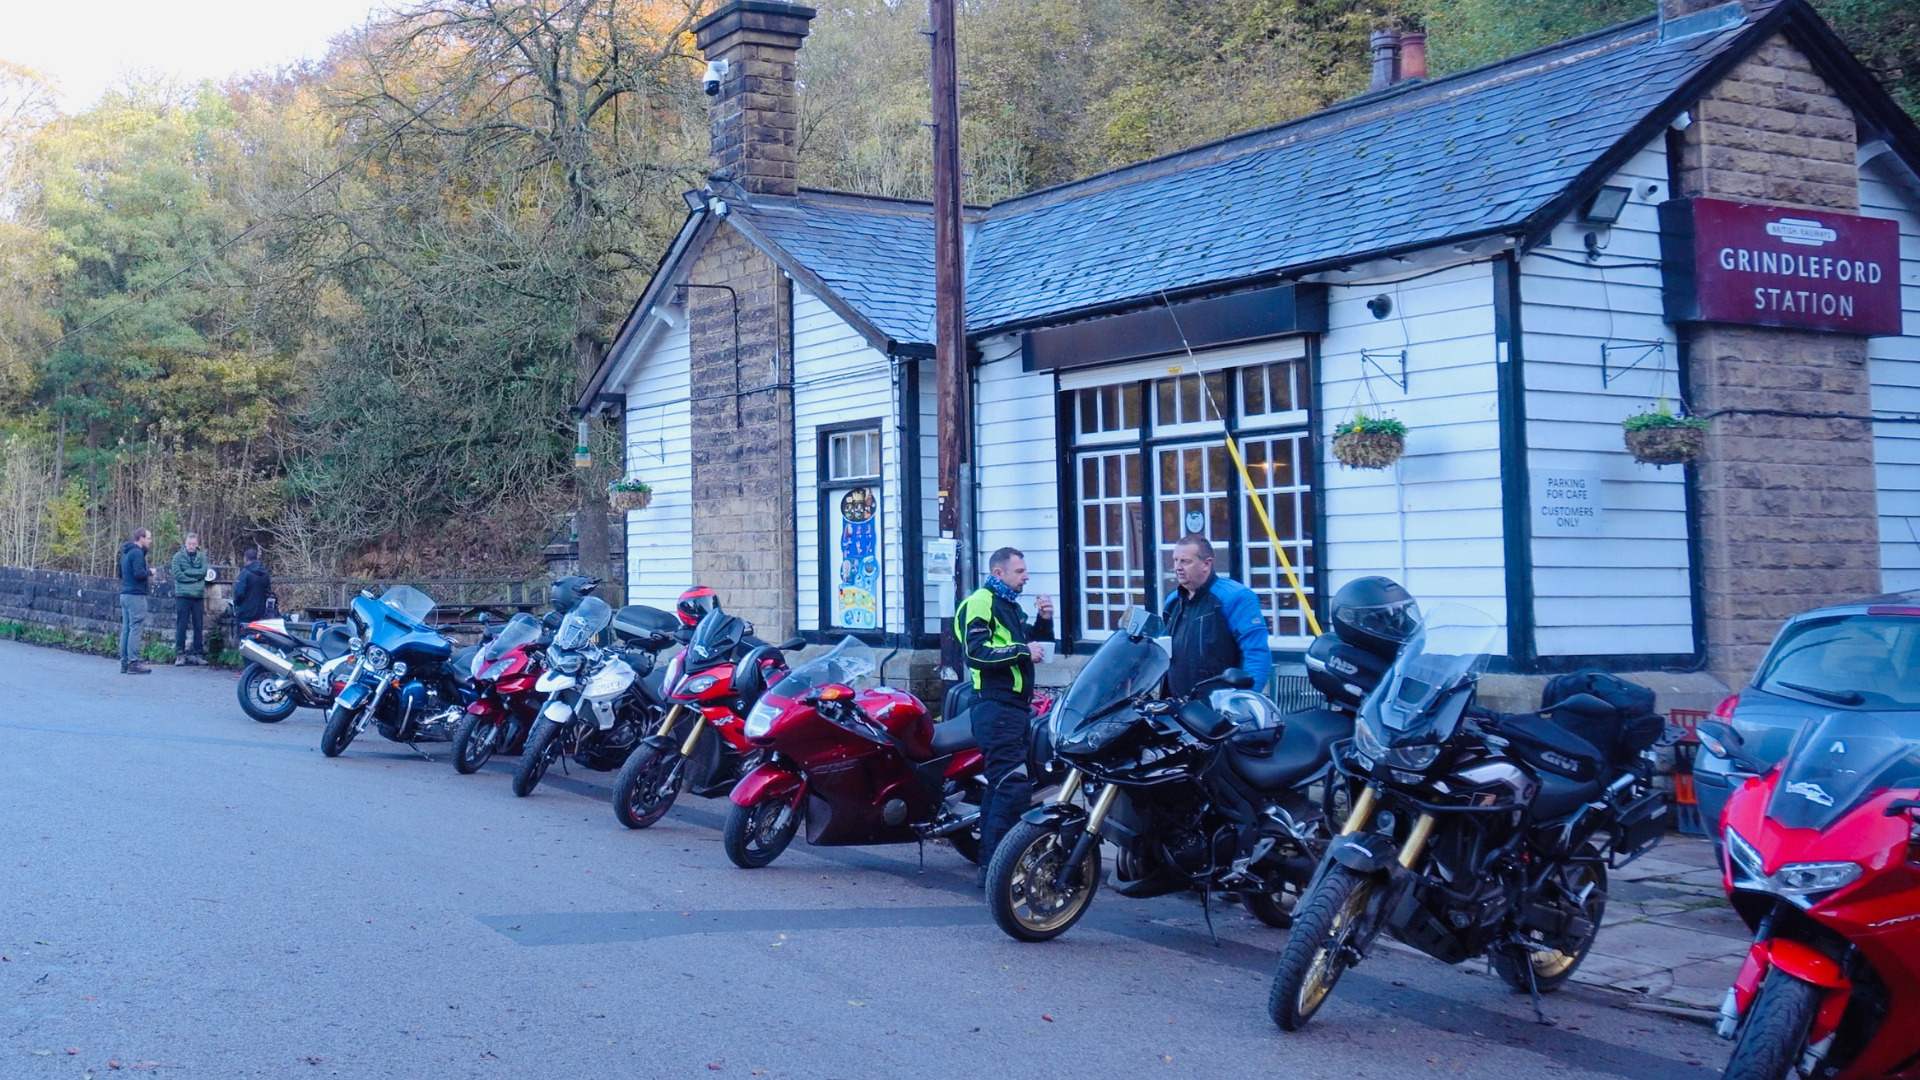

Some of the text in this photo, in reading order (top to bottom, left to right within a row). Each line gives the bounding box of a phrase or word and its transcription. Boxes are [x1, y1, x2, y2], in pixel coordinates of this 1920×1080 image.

[1771, 225, 1832, 239] BRITISH RAILWAYS
[1720, 247, 1882, 284] GRINDLEFORD
[1755, 287, 1853, 317] STATION
[1548, 477, 1586, 489] PARKING
[1547, 489, 1588, 500] FOR CAFE
[1541, 506, 1594, 517] CUSTOMERS
[1557, 517, 1580, 527] ONLY
[593, 681, 628, 694] TIGER
[1540, 751, 1580, 773] GIVI
